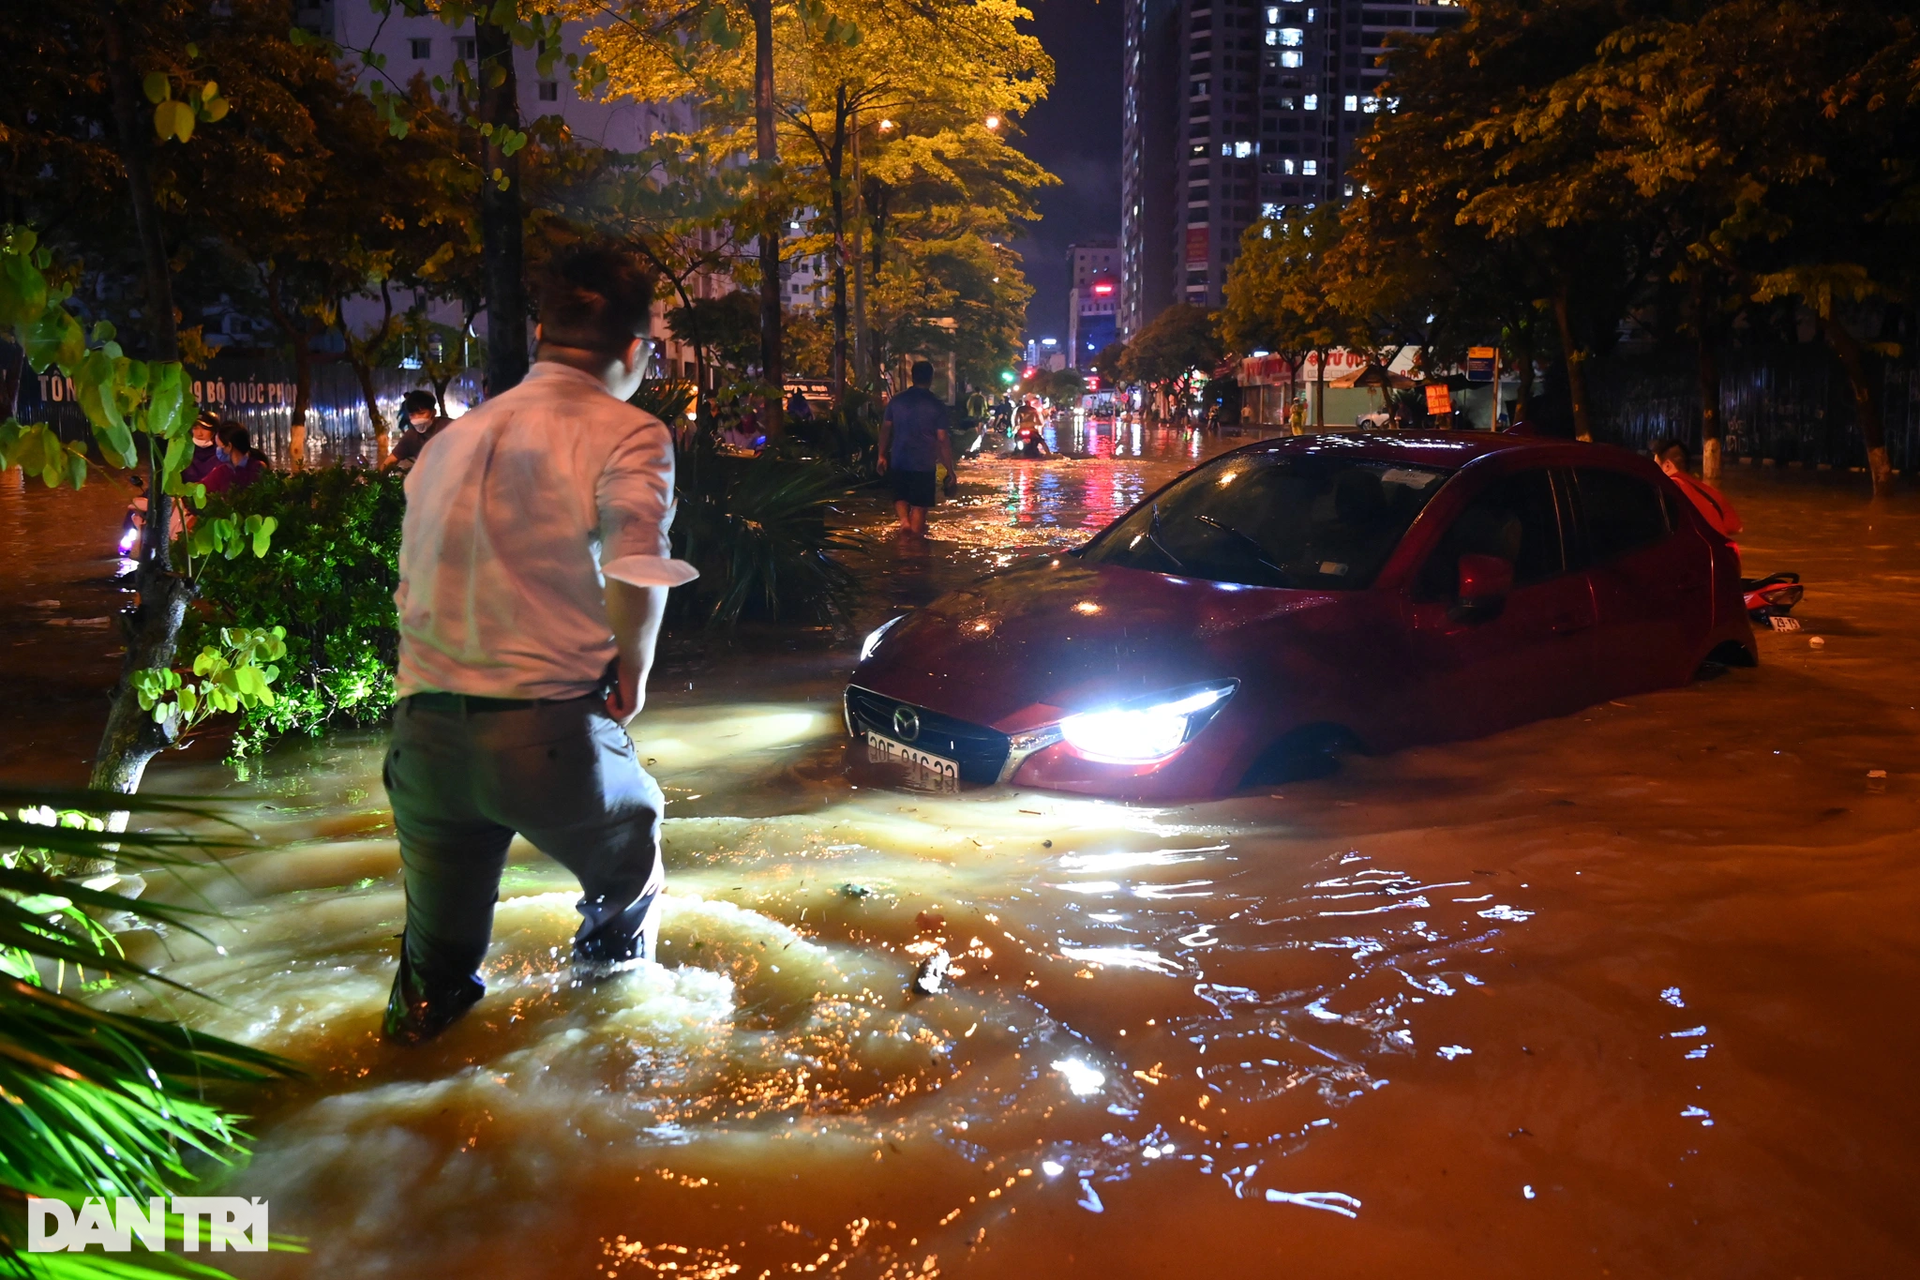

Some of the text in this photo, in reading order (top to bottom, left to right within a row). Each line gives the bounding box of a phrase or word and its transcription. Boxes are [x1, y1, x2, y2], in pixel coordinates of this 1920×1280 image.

[206, 376, 226, 409] BỘ
[229, 373, 265, 405] QUỐC
[267, 377, 298, 404] PHÒN
